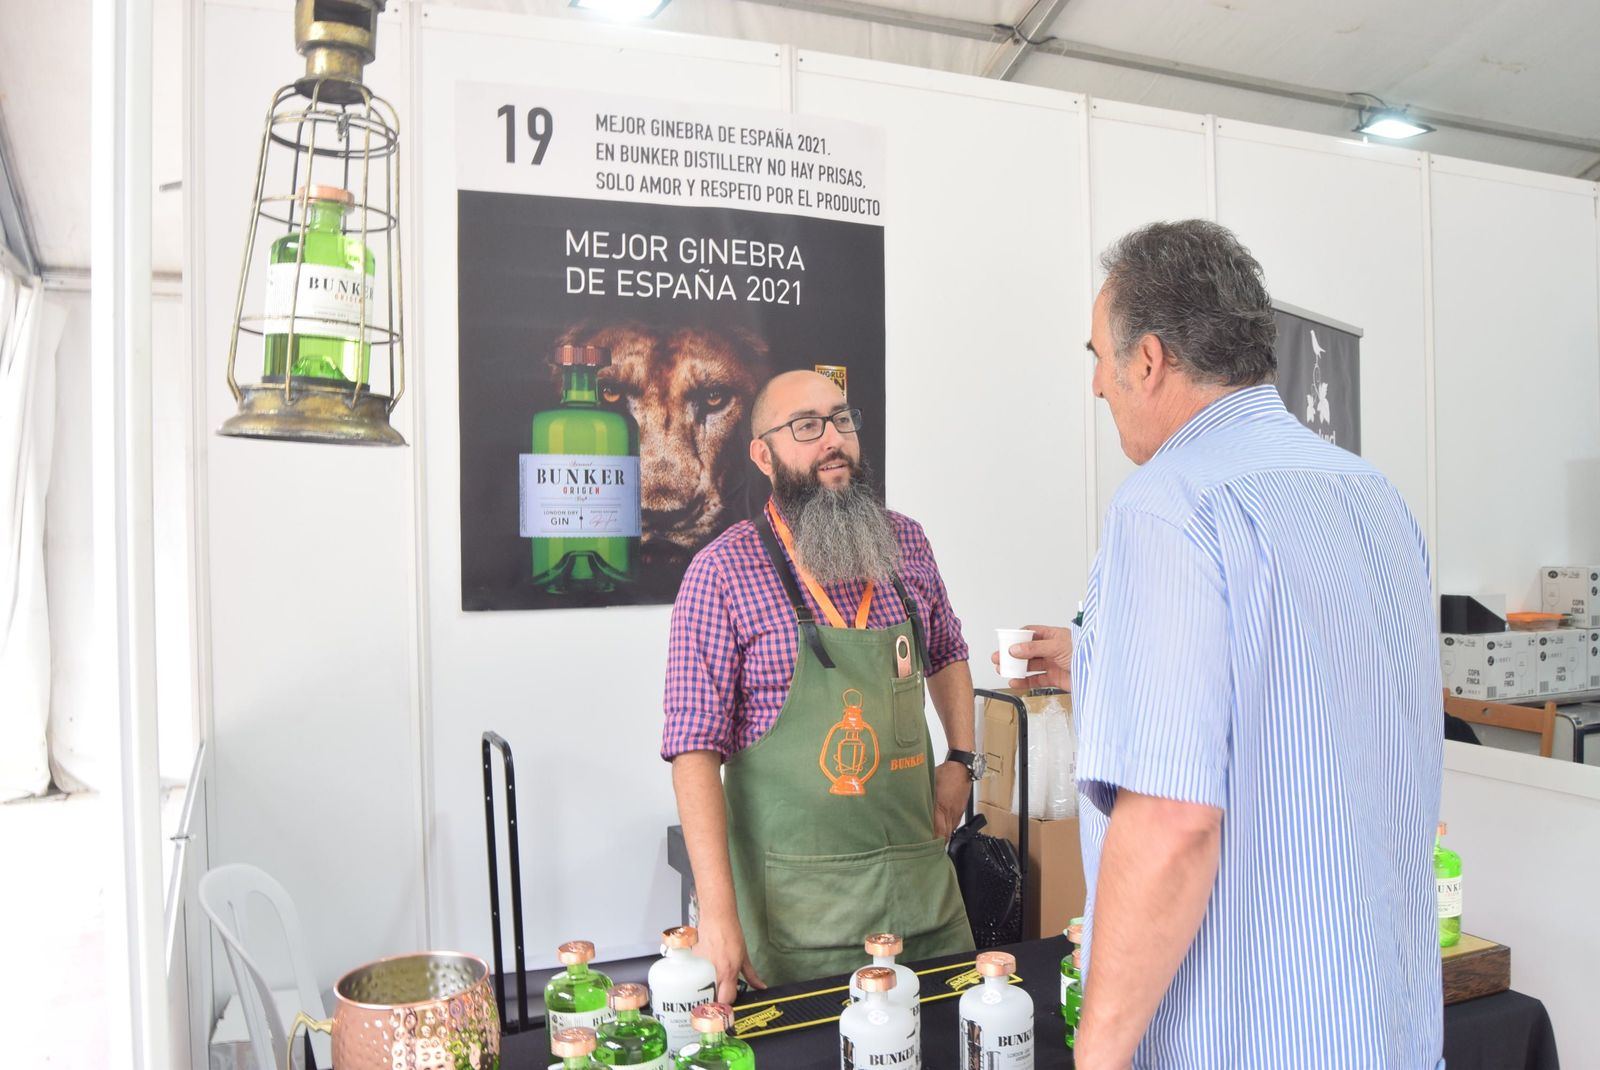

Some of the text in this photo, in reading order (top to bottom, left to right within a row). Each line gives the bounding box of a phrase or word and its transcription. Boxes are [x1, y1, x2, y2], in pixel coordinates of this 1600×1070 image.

[497, 104, 553, 166] 19
[596, 113, 831, 156] MEJOR GINEBRA DE ESPAÑA 2021.
[596, 142, 615, 161] EN
[620, 144, 679, 167] BUNKER
[684, 150, 763, 175] DISTILLERY
[767, 158, 786, 177] NO
[791, 160, 815, 180] HAY
[596, 171, 881, 217] SOLO AMOR Y RESPETO POR EL PRODUCTO
[565, 229, 805, 271] MEJOR GINEBRA
[566, 266, 801, 306] DE ESPAÑA 2021
[536, 467, 625, 485] BUNKER
[550, 516, 569, 525] GIN
[1466, 677, 1480, 685] FINCA
[1468, 669, 1480, 677] COPA
[1438, 883, 1461, 893] UNK
